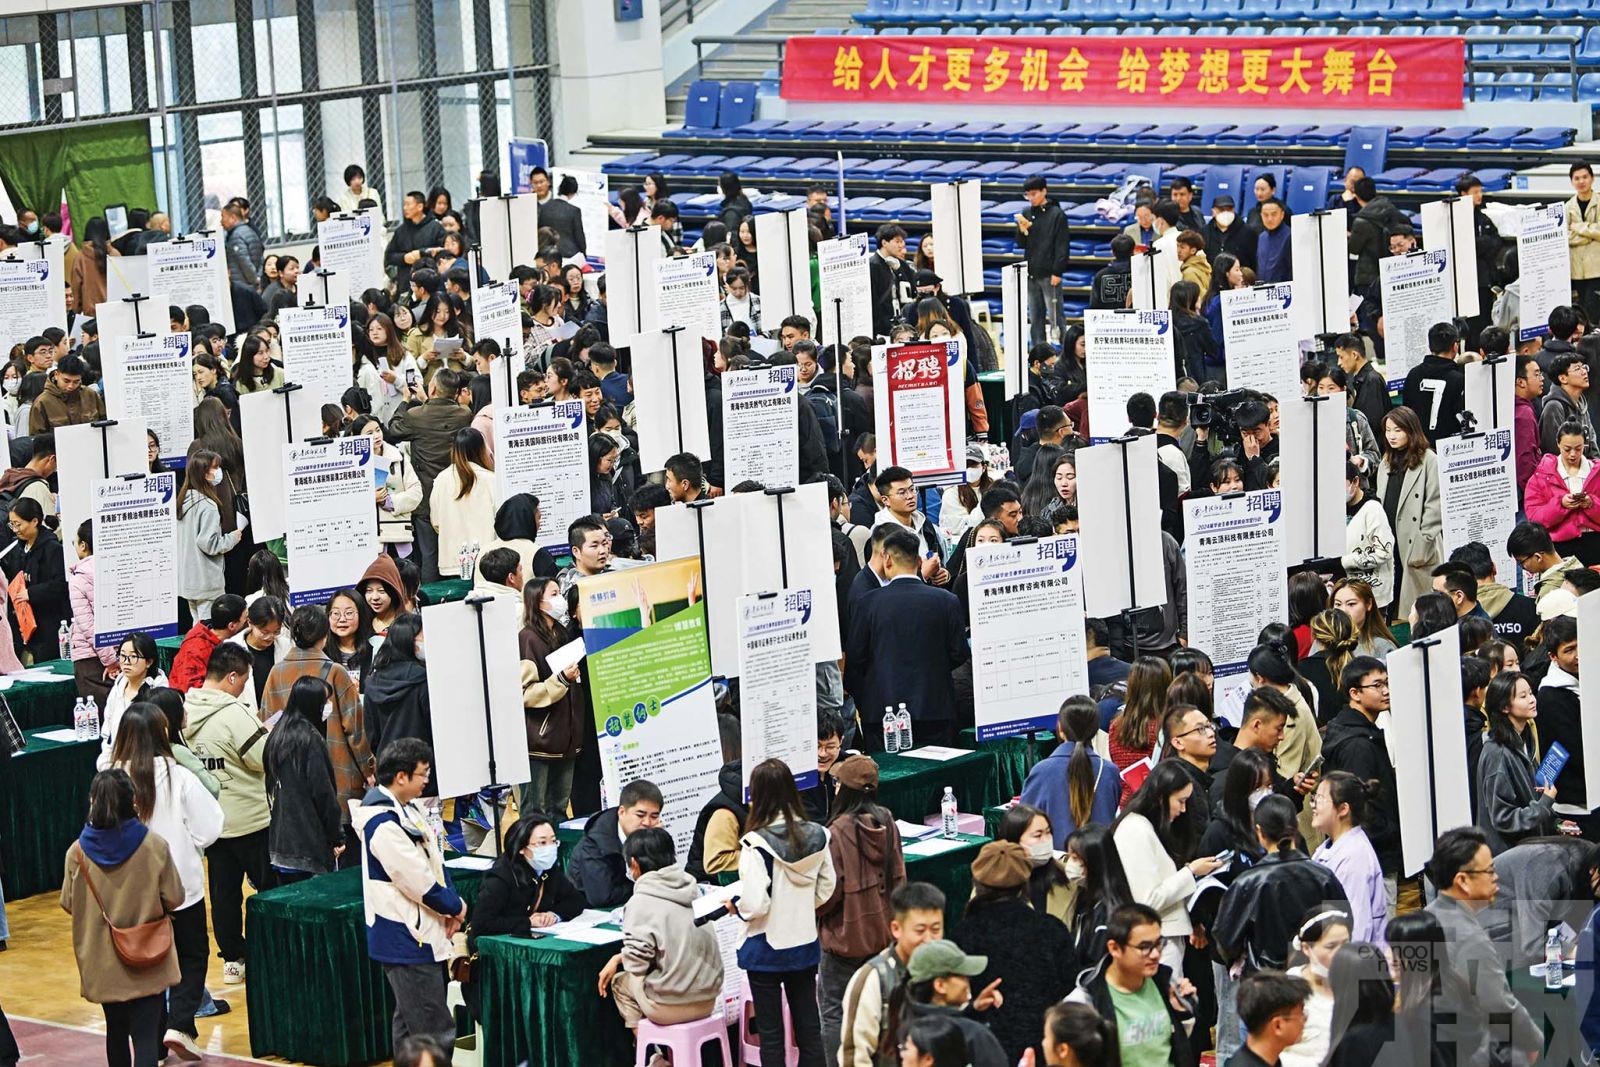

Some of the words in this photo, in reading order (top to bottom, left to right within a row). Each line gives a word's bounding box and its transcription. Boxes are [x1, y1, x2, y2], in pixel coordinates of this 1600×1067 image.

[832, 46, 1090, 92] 给人才更多机会
[1117, 47, 1398, 95] 给梦想更大舞台
[1423, 250, 1446, 265] 招聘
[1266, 285, 1291, 301] 招聘
[324, 306, 347, 319] 招聘
[1139, 311, 1168, 325] 招聘
[164, 335, 188, 348] 招聘
[768, 367, 795, 384] 招聘
[891, 355, 941, 380] 招聘
[551, 401, 582, 419] 招聘
[730, 397, 792, 411] 青海中浩天然气化工有限公司
[1420, 378, 1447, 430] 7
[339, 438, 371, 456] 招聘
[1484, 430, 1511, 450] 招聘
[144, 475, 173, 493] 招聘
[1246, 491, 1282, 512] 招聘
[101, 508, 170, 523] 青海新丁香粮油有限责任公司
[1199, 528, 1274, 546] 青海云顶科技有限责任公司
[1036, 538, 1077, 560] 招聘
[984, 577, 1068, 597] 青海博慧教育咨询有限公司
[785, 590, 811, 612] 招聘
